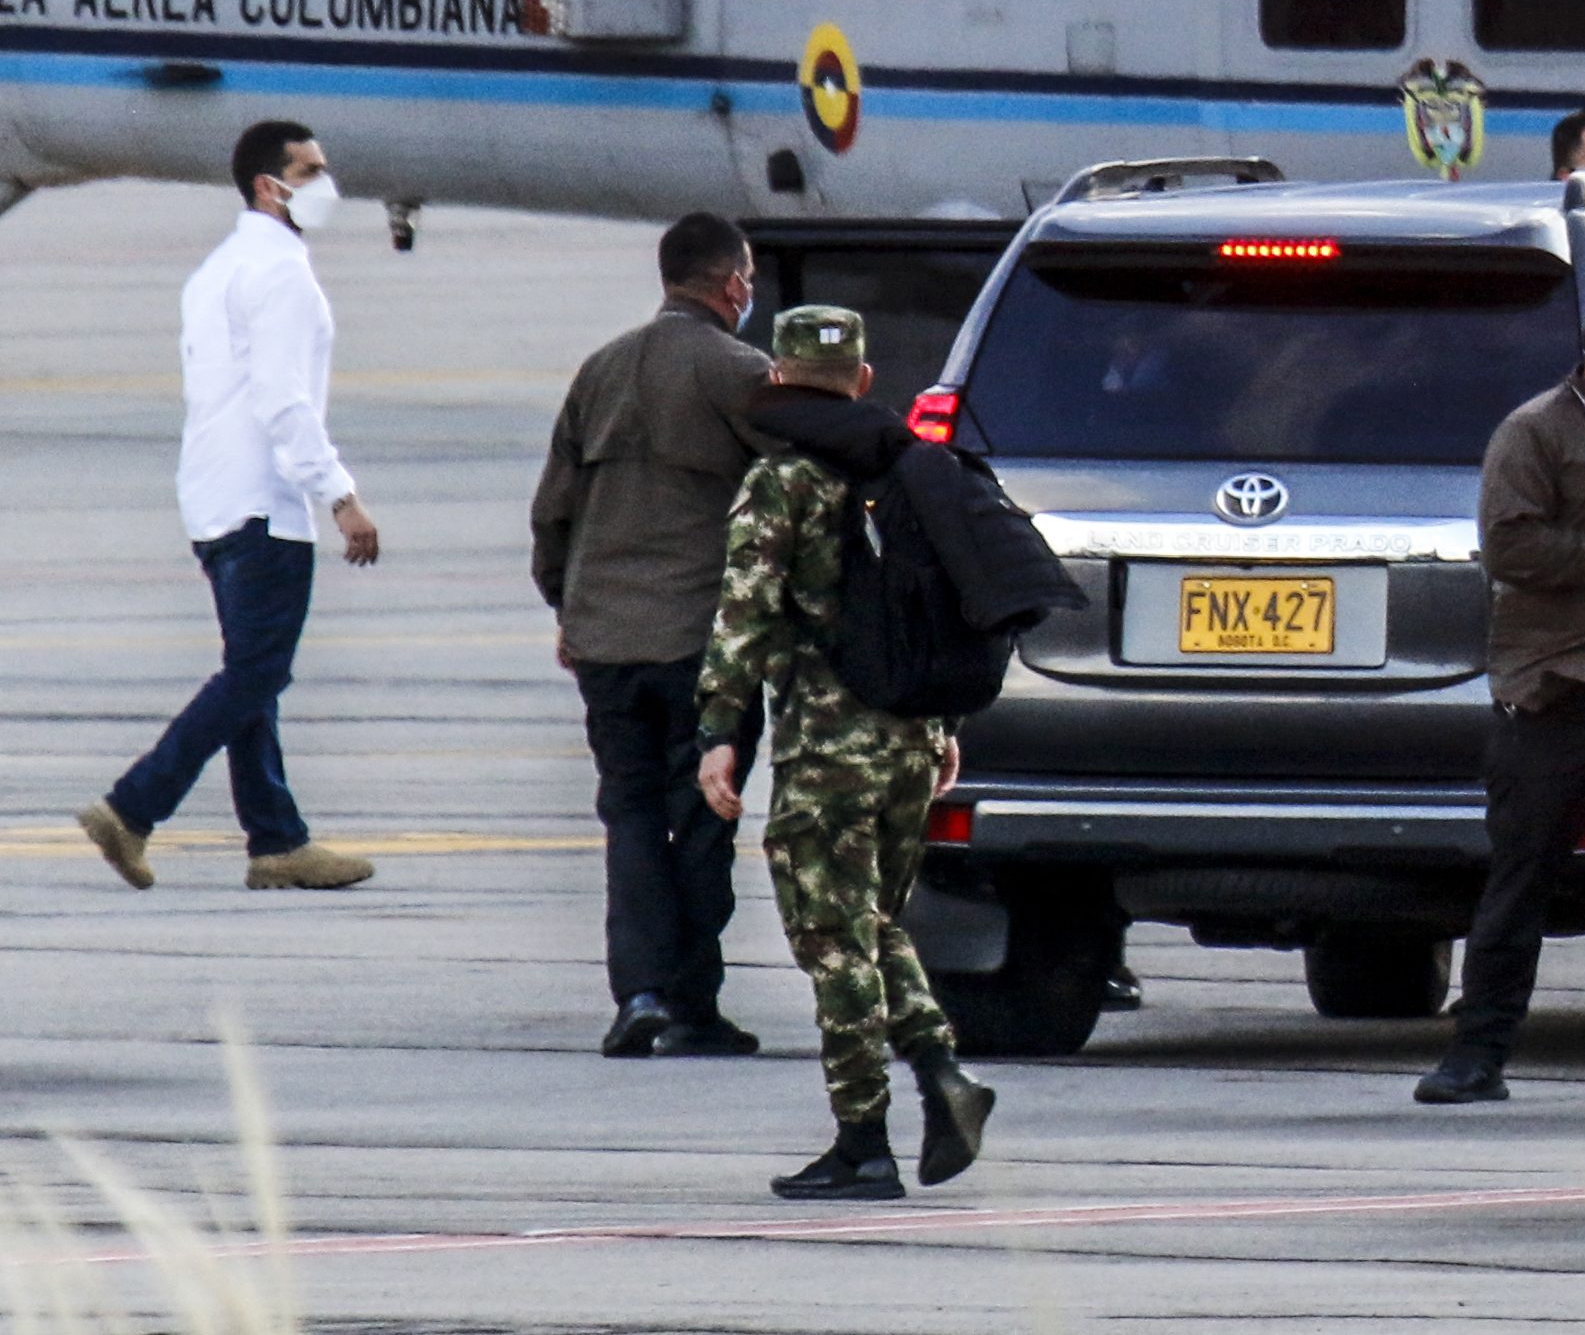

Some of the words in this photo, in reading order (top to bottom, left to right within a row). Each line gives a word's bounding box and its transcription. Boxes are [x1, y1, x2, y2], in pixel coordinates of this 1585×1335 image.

[1086, 530, 1164, 551] LAND
[1171, 532, 1300, 553] CRUISER
[1308, 533, 1412, 554] PRADO
